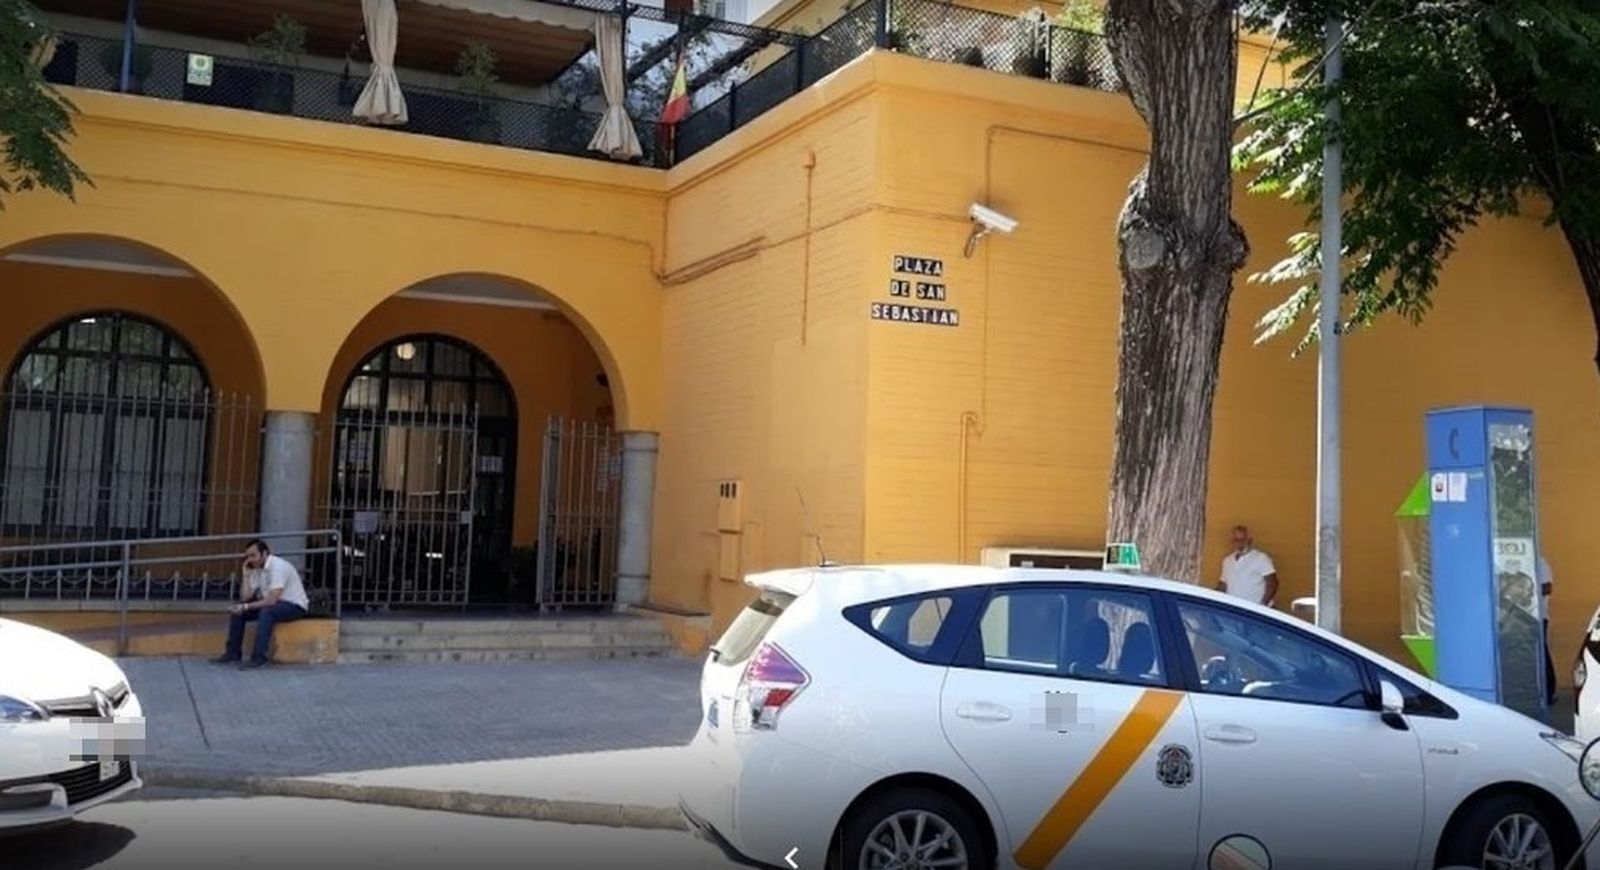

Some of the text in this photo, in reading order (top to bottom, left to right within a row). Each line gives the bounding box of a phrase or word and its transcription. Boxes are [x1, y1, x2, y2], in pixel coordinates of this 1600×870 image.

[895, 257, 942, 275] PLAZA
[891, 281, 944, 300] DE SAN
[872, 304, 958, 324] SEBASTIAN
